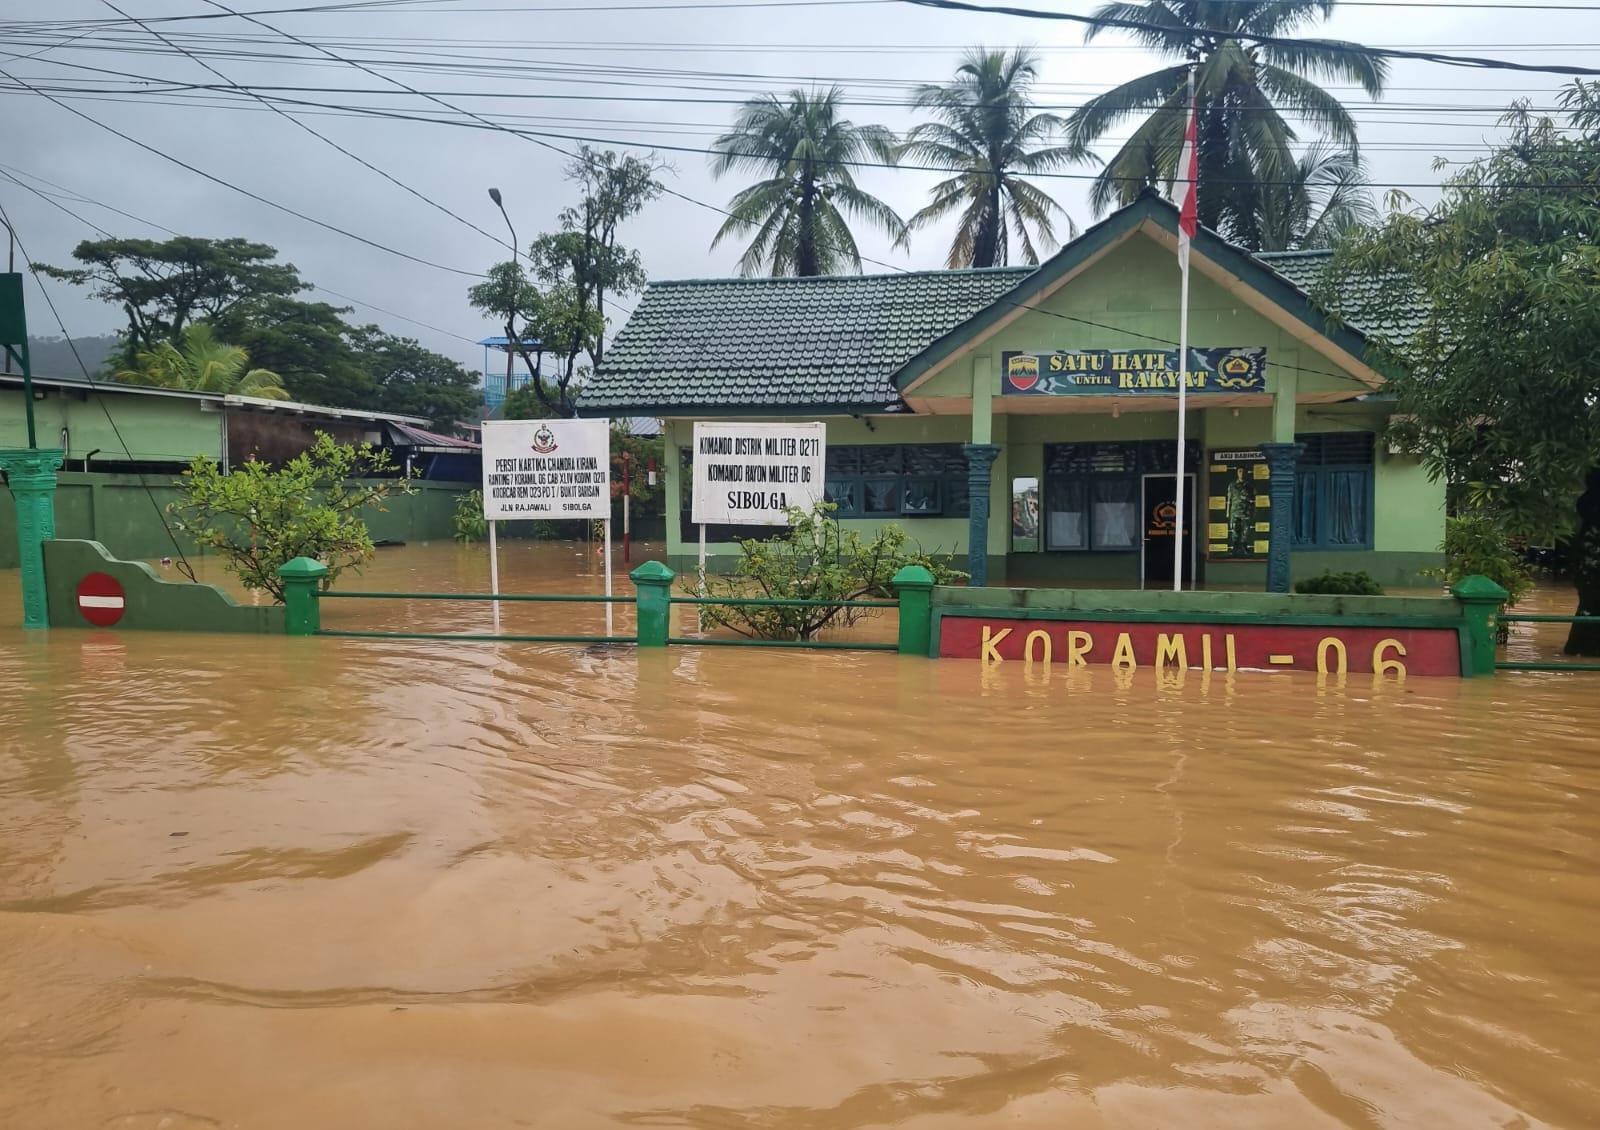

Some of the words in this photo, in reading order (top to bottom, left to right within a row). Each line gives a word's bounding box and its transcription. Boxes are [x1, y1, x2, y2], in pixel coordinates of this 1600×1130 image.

[1049, 354, 1105, 371] SATU
[1111, 353, 1165, 371] HATI
[1076, 376, 1112, 385] UNTUK
[1118, 371, 1209, 388] RAKYAT
[700, 437, 732, 455] KOMANDO
[735, 437, 762, 455] DISTRIK
[765, 438, 796, 456] MILITER
[799, 438, 819, 456] 0211
[496, 458, 517, 472] PERSIT
[519, 458, 546, 471] KARTIKA
[547, 457, 575, 471] CHANDRA
[576, 457, 597, 470] KIRANA
[708, 464, 743, 481] KOMANDO
[745, 465, 766, 482] RAYON
[769, 465, 798, 482] MILITER
[801, 466, 811, 482] 06
[515, 473, 536, 485] KORAMIL
[547, 473, 558, 484] CAB
[574, 472, 591, 483] KODIM
[517, 487, 528, 498] REM
[529, 487, 541, 498] 023
[560, 486, 576, 497] BUKIT
[578, 486, 600, 497] BARISAN
[727, 491, 786, 509] SIBOLGA
[562, 503, 592, 511] SIBOLGA
